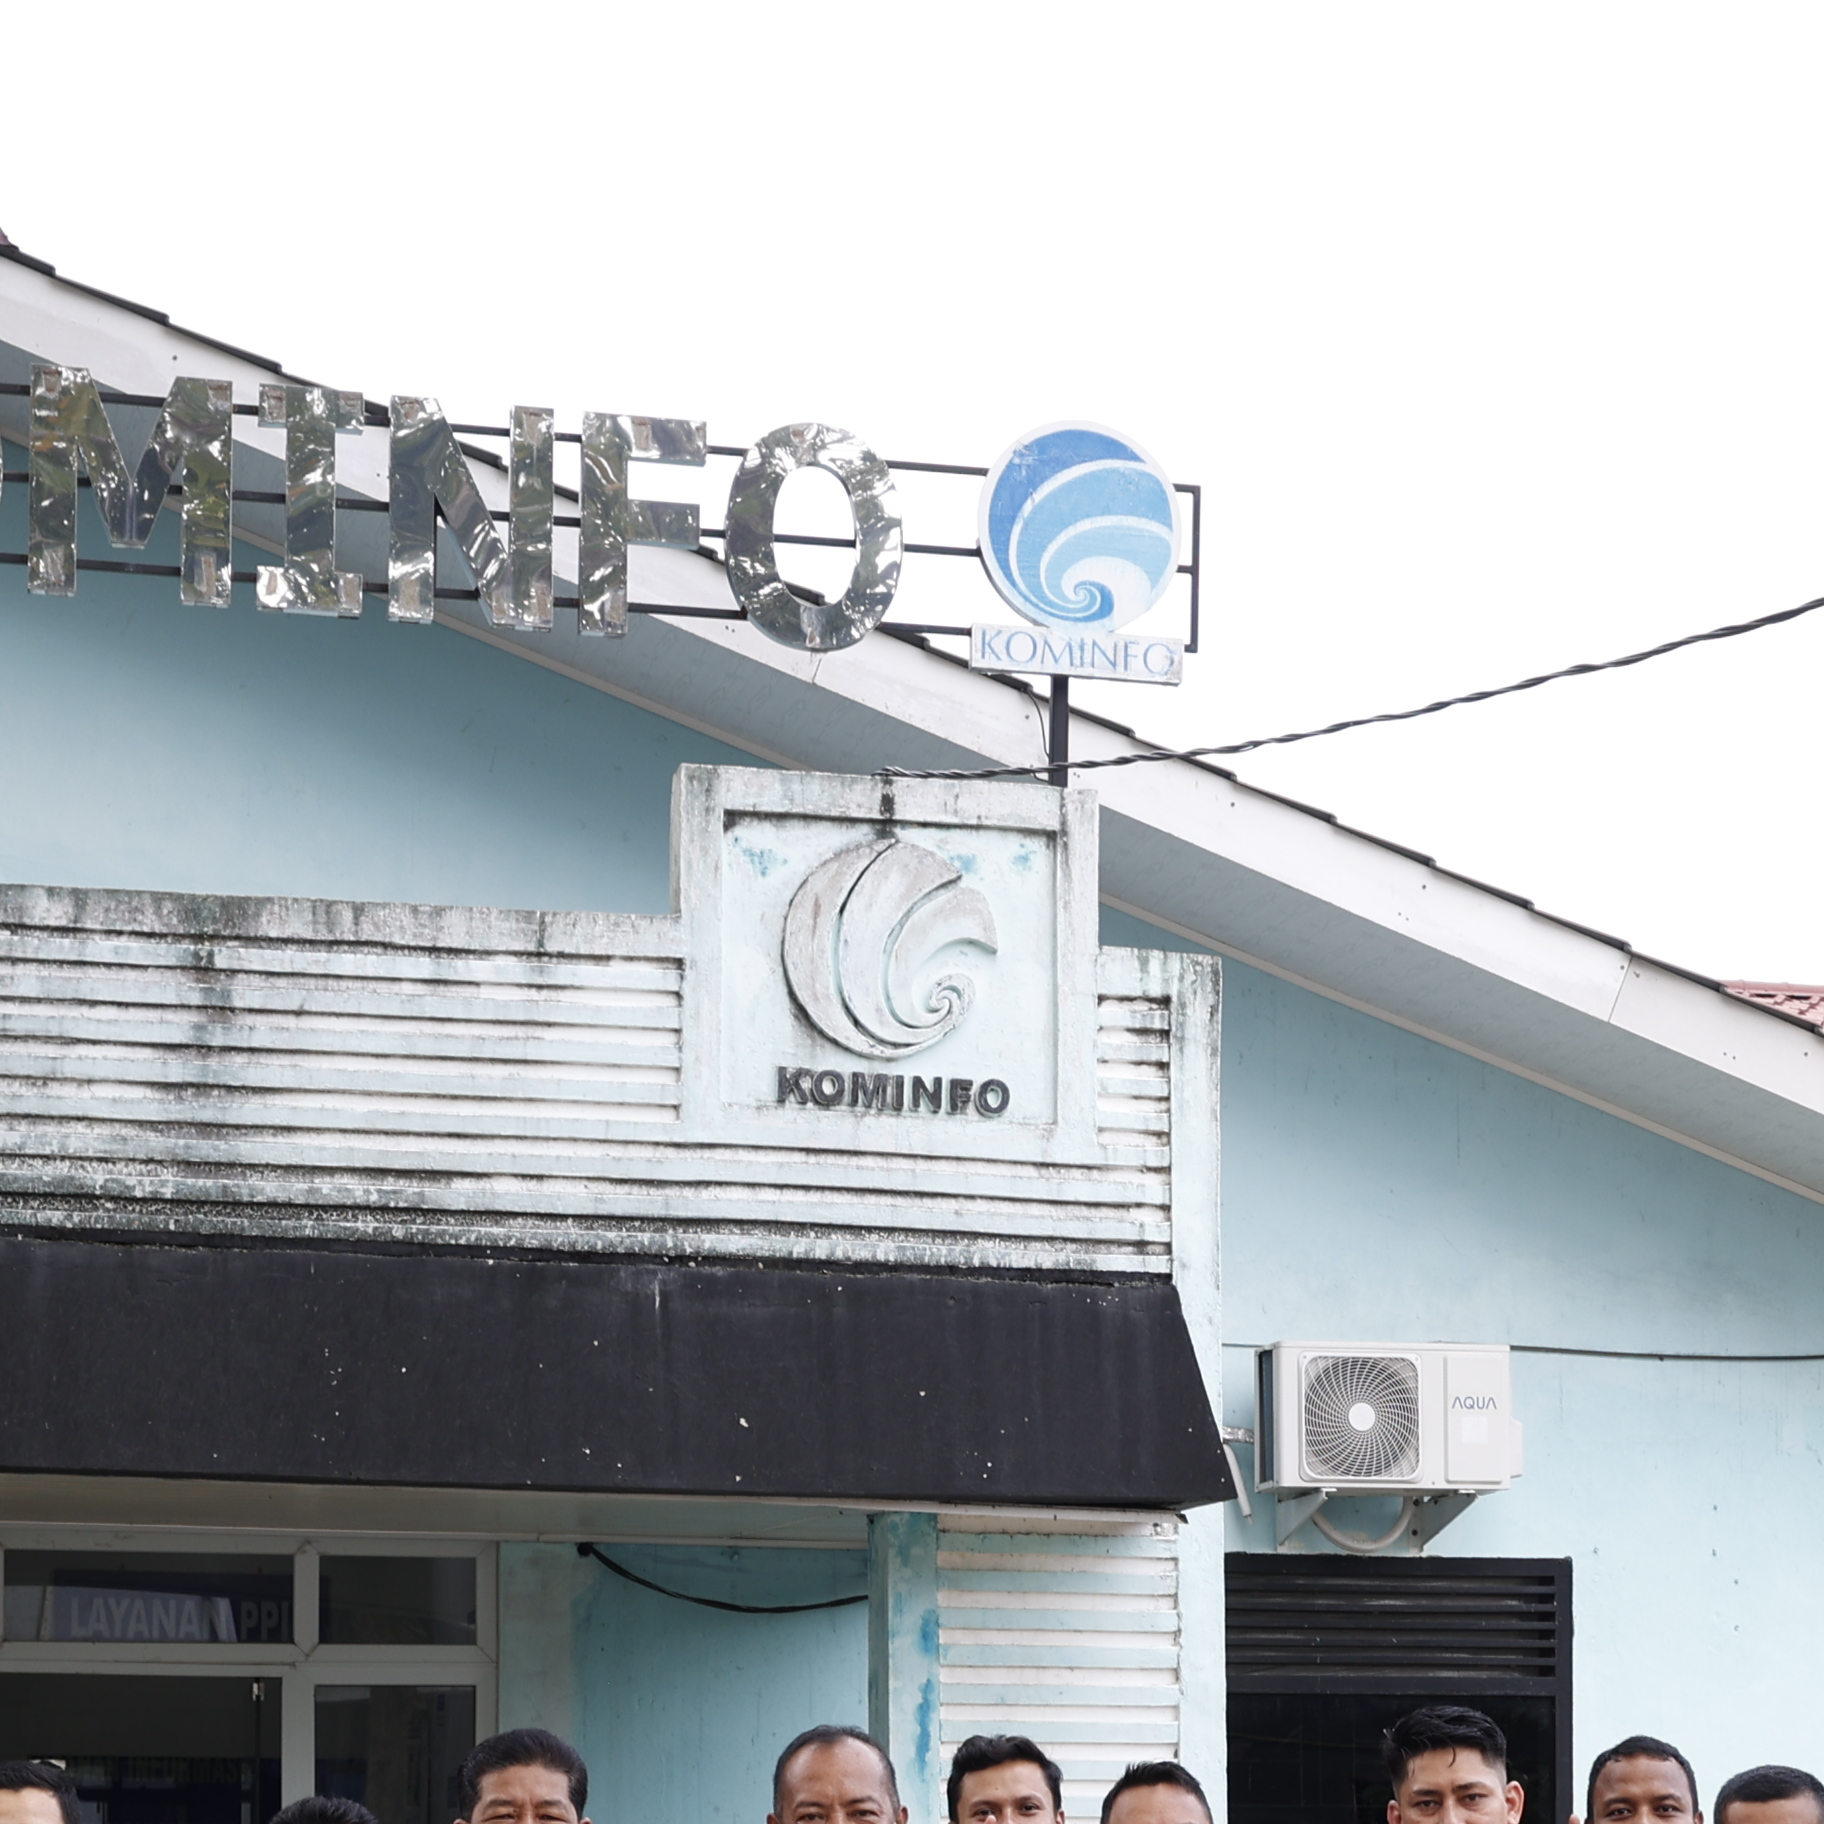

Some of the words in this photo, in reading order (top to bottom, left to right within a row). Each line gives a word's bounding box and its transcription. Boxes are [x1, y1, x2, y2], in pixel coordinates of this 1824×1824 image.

[979, 627, 1179, 676] KOMINFO
[776, 1066, 1011, 1119] KOMINFO
[1451, 1396, 1498, 1411] AQUA
[71, 1597, 229, 1642] LAYANAN
